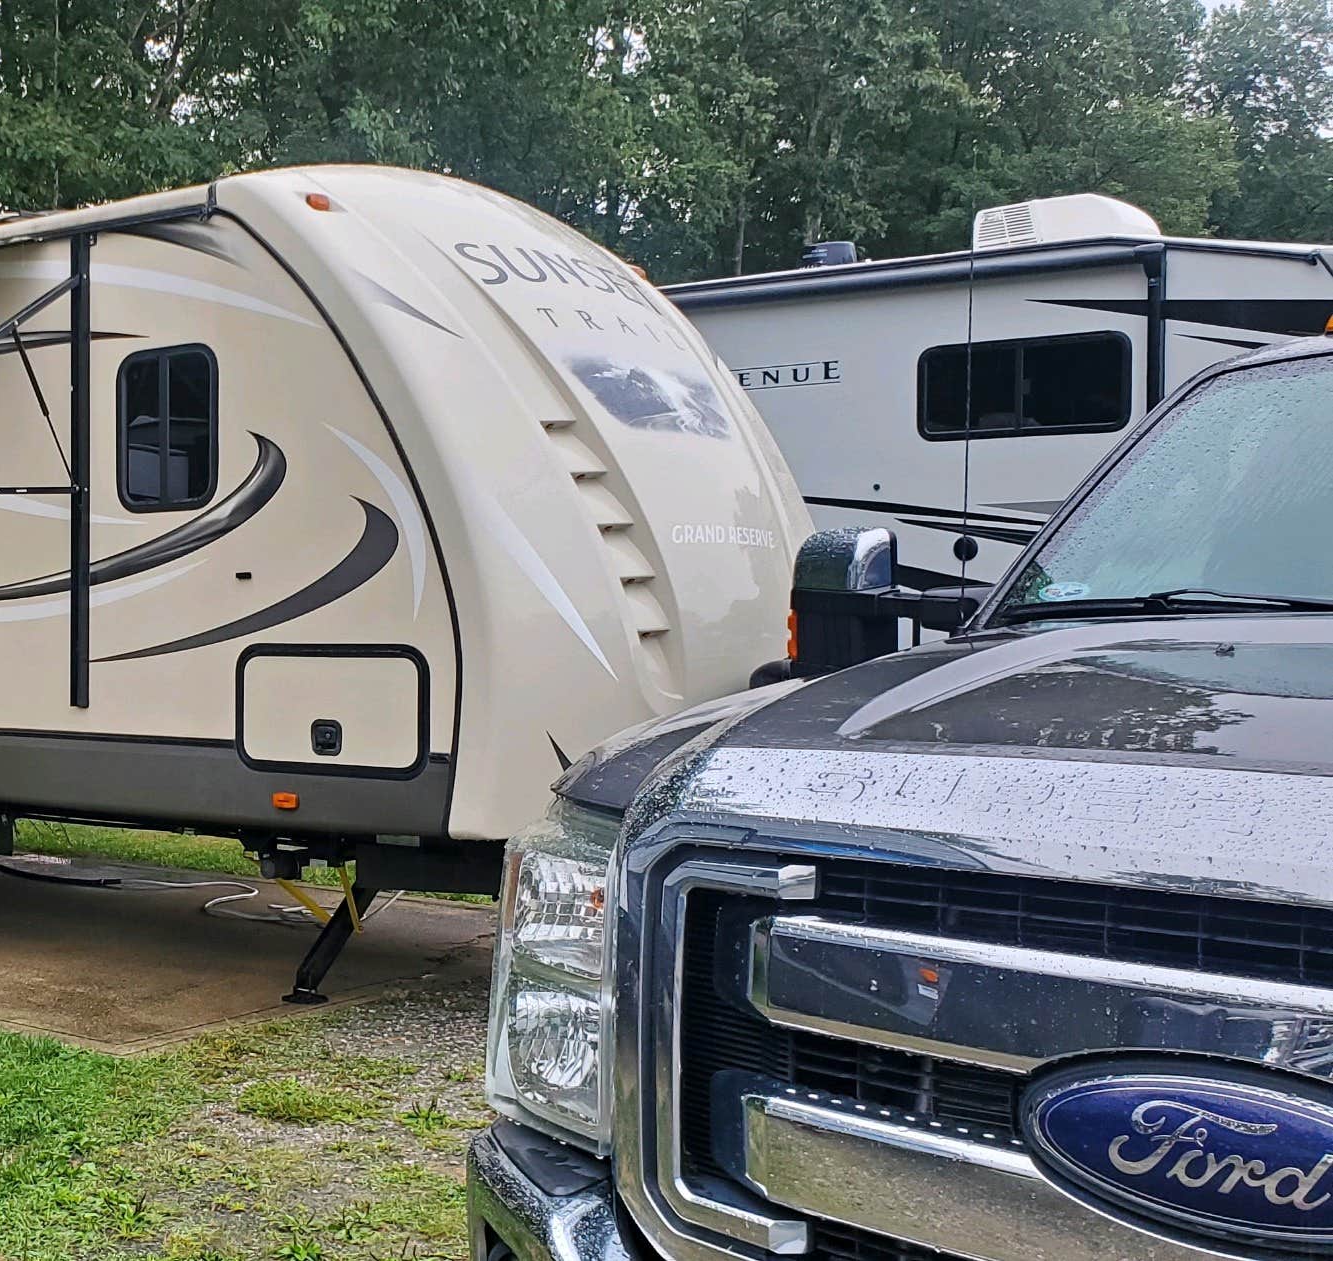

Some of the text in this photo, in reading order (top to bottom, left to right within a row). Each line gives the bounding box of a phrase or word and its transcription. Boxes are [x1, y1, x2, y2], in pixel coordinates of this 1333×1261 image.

[454, 242, 663, 316] SUNSET
[536, 307, 688, 351] TRAIL
[671, 524, 775, 549] GRAND RESERVE
[1108, 1100, 1333, 1211] Ford
